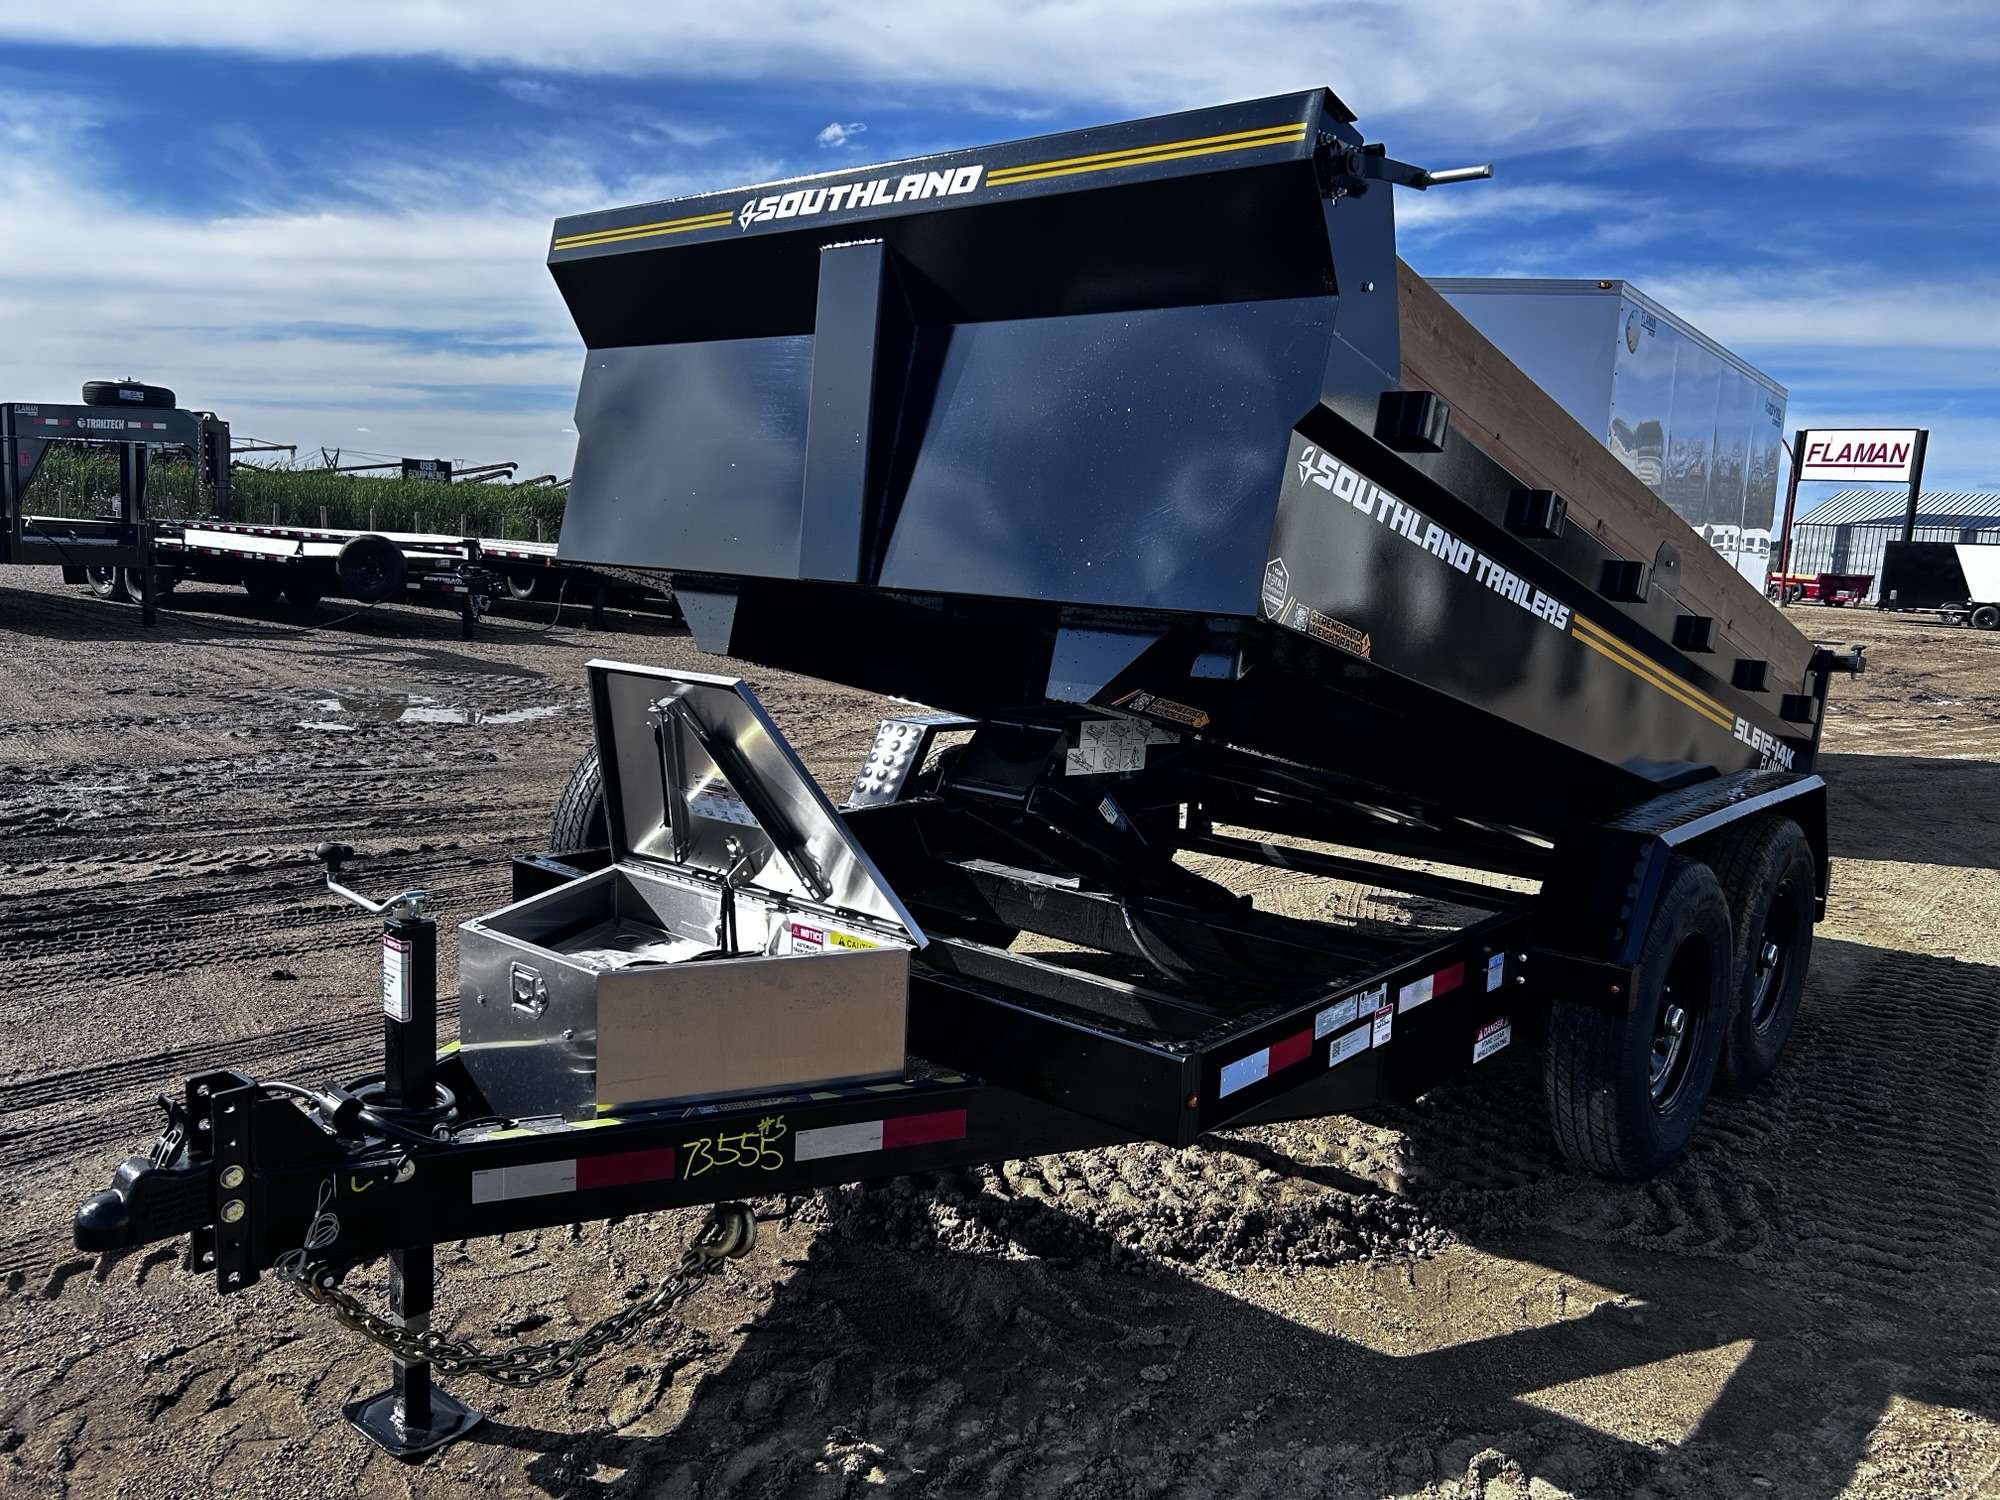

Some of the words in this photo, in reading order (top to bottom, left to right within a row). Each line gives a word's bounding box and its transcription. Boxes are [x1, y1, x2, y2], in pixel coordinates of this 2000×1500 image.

[753, 165, 984, 222] SOUTHLAND
[86, 418, 125, 430] TRAILTECH
[420, 461, 438, 471] USED
[1807, 443, 1910, 463] FLAMAN
[1312, 453, 1475, 575] SOUTHLAND
[1475, 553, 1571, 631] TRAILERS
[1311, 610, 1352, 638] STRENGTH
[1310, 622, 1340, 646] WEIGHT
[1340, 634, 1361, 655] RATIO
[1733, 716, 1796, 770] SL612-14K
[801, 926, 823, 943] NOTICE
[1483, 1018, 1504, 1037] DANGER
[683, 1130, 784, 1180] 73555
